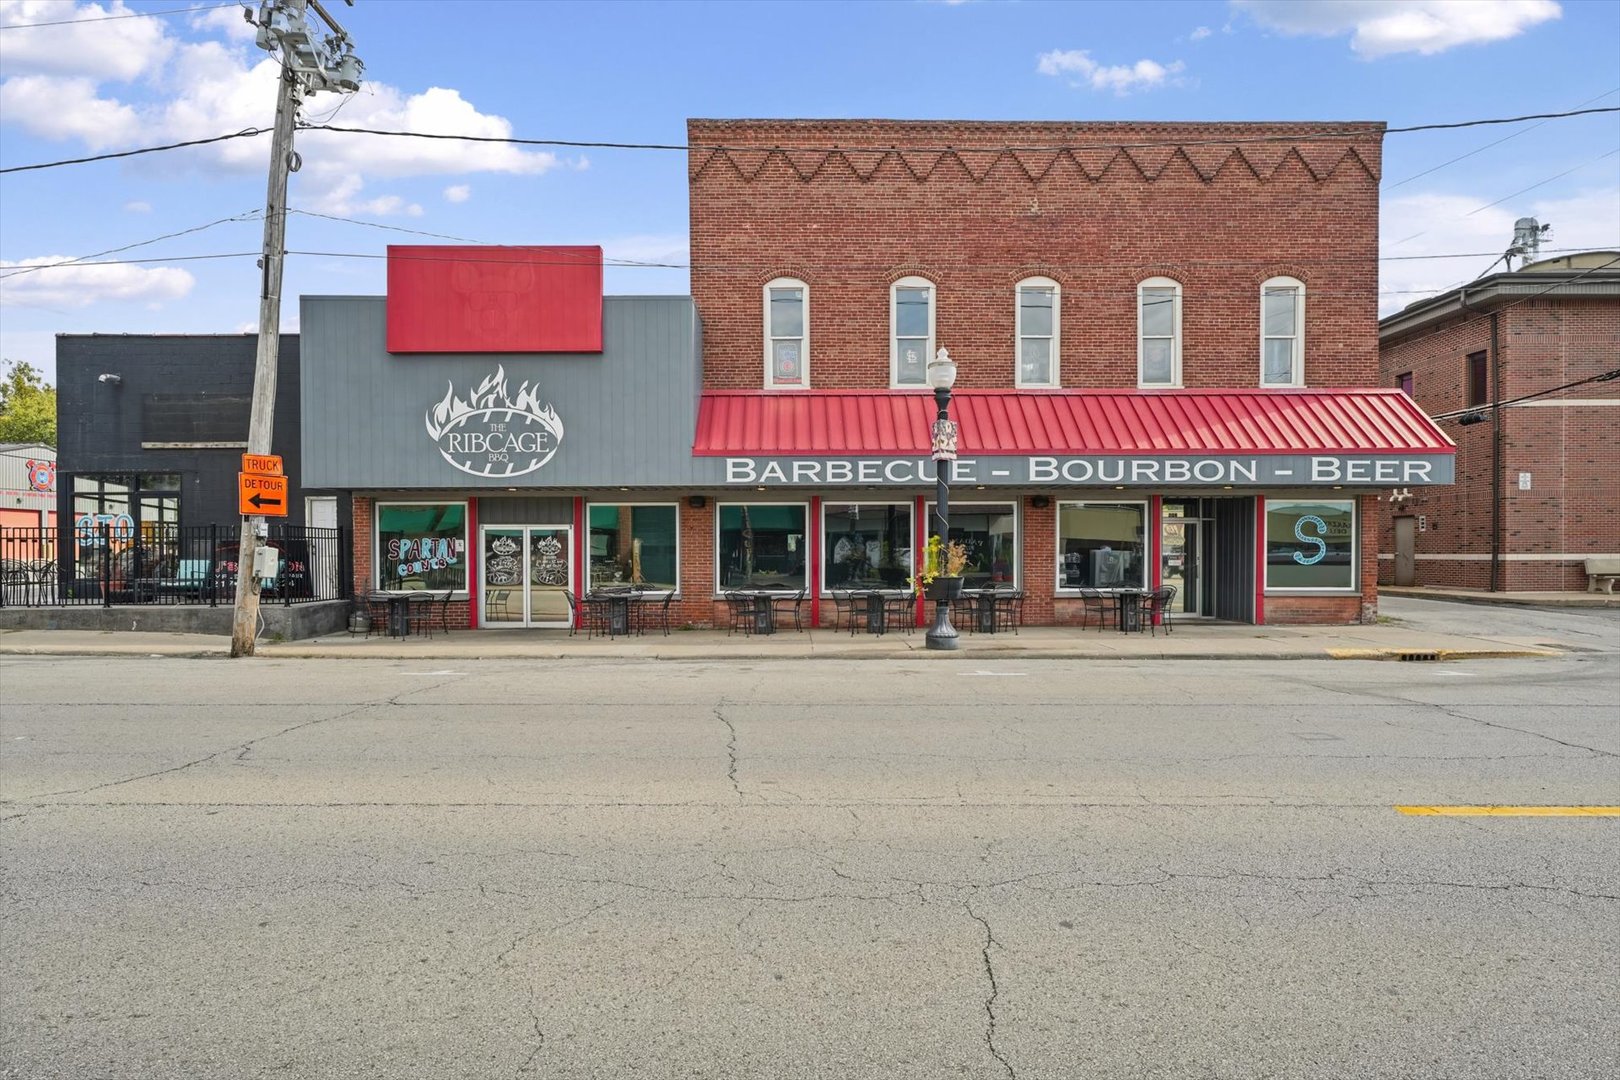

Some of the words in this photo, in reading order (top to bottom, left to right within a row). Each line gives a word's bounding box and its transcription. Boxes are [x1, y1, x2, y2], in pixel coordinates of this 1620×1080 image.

[489, 423, 507, 432] THE
[447, 432, 549, 453] RIBCAGE
[246, 458, 280, 472] TRUCK
[488, 453, 509, 463] BBQ
[725, 457, 977, 483] BARBECUE
[1028, 456, 1257, 483] BOURBON
[1311, 456, 1433, 483] BEER
[244, 477, 283, 491] DETOUR
[387, 537, 457, 560] SPARTAN
[1292, 514, 1327, 566] S
